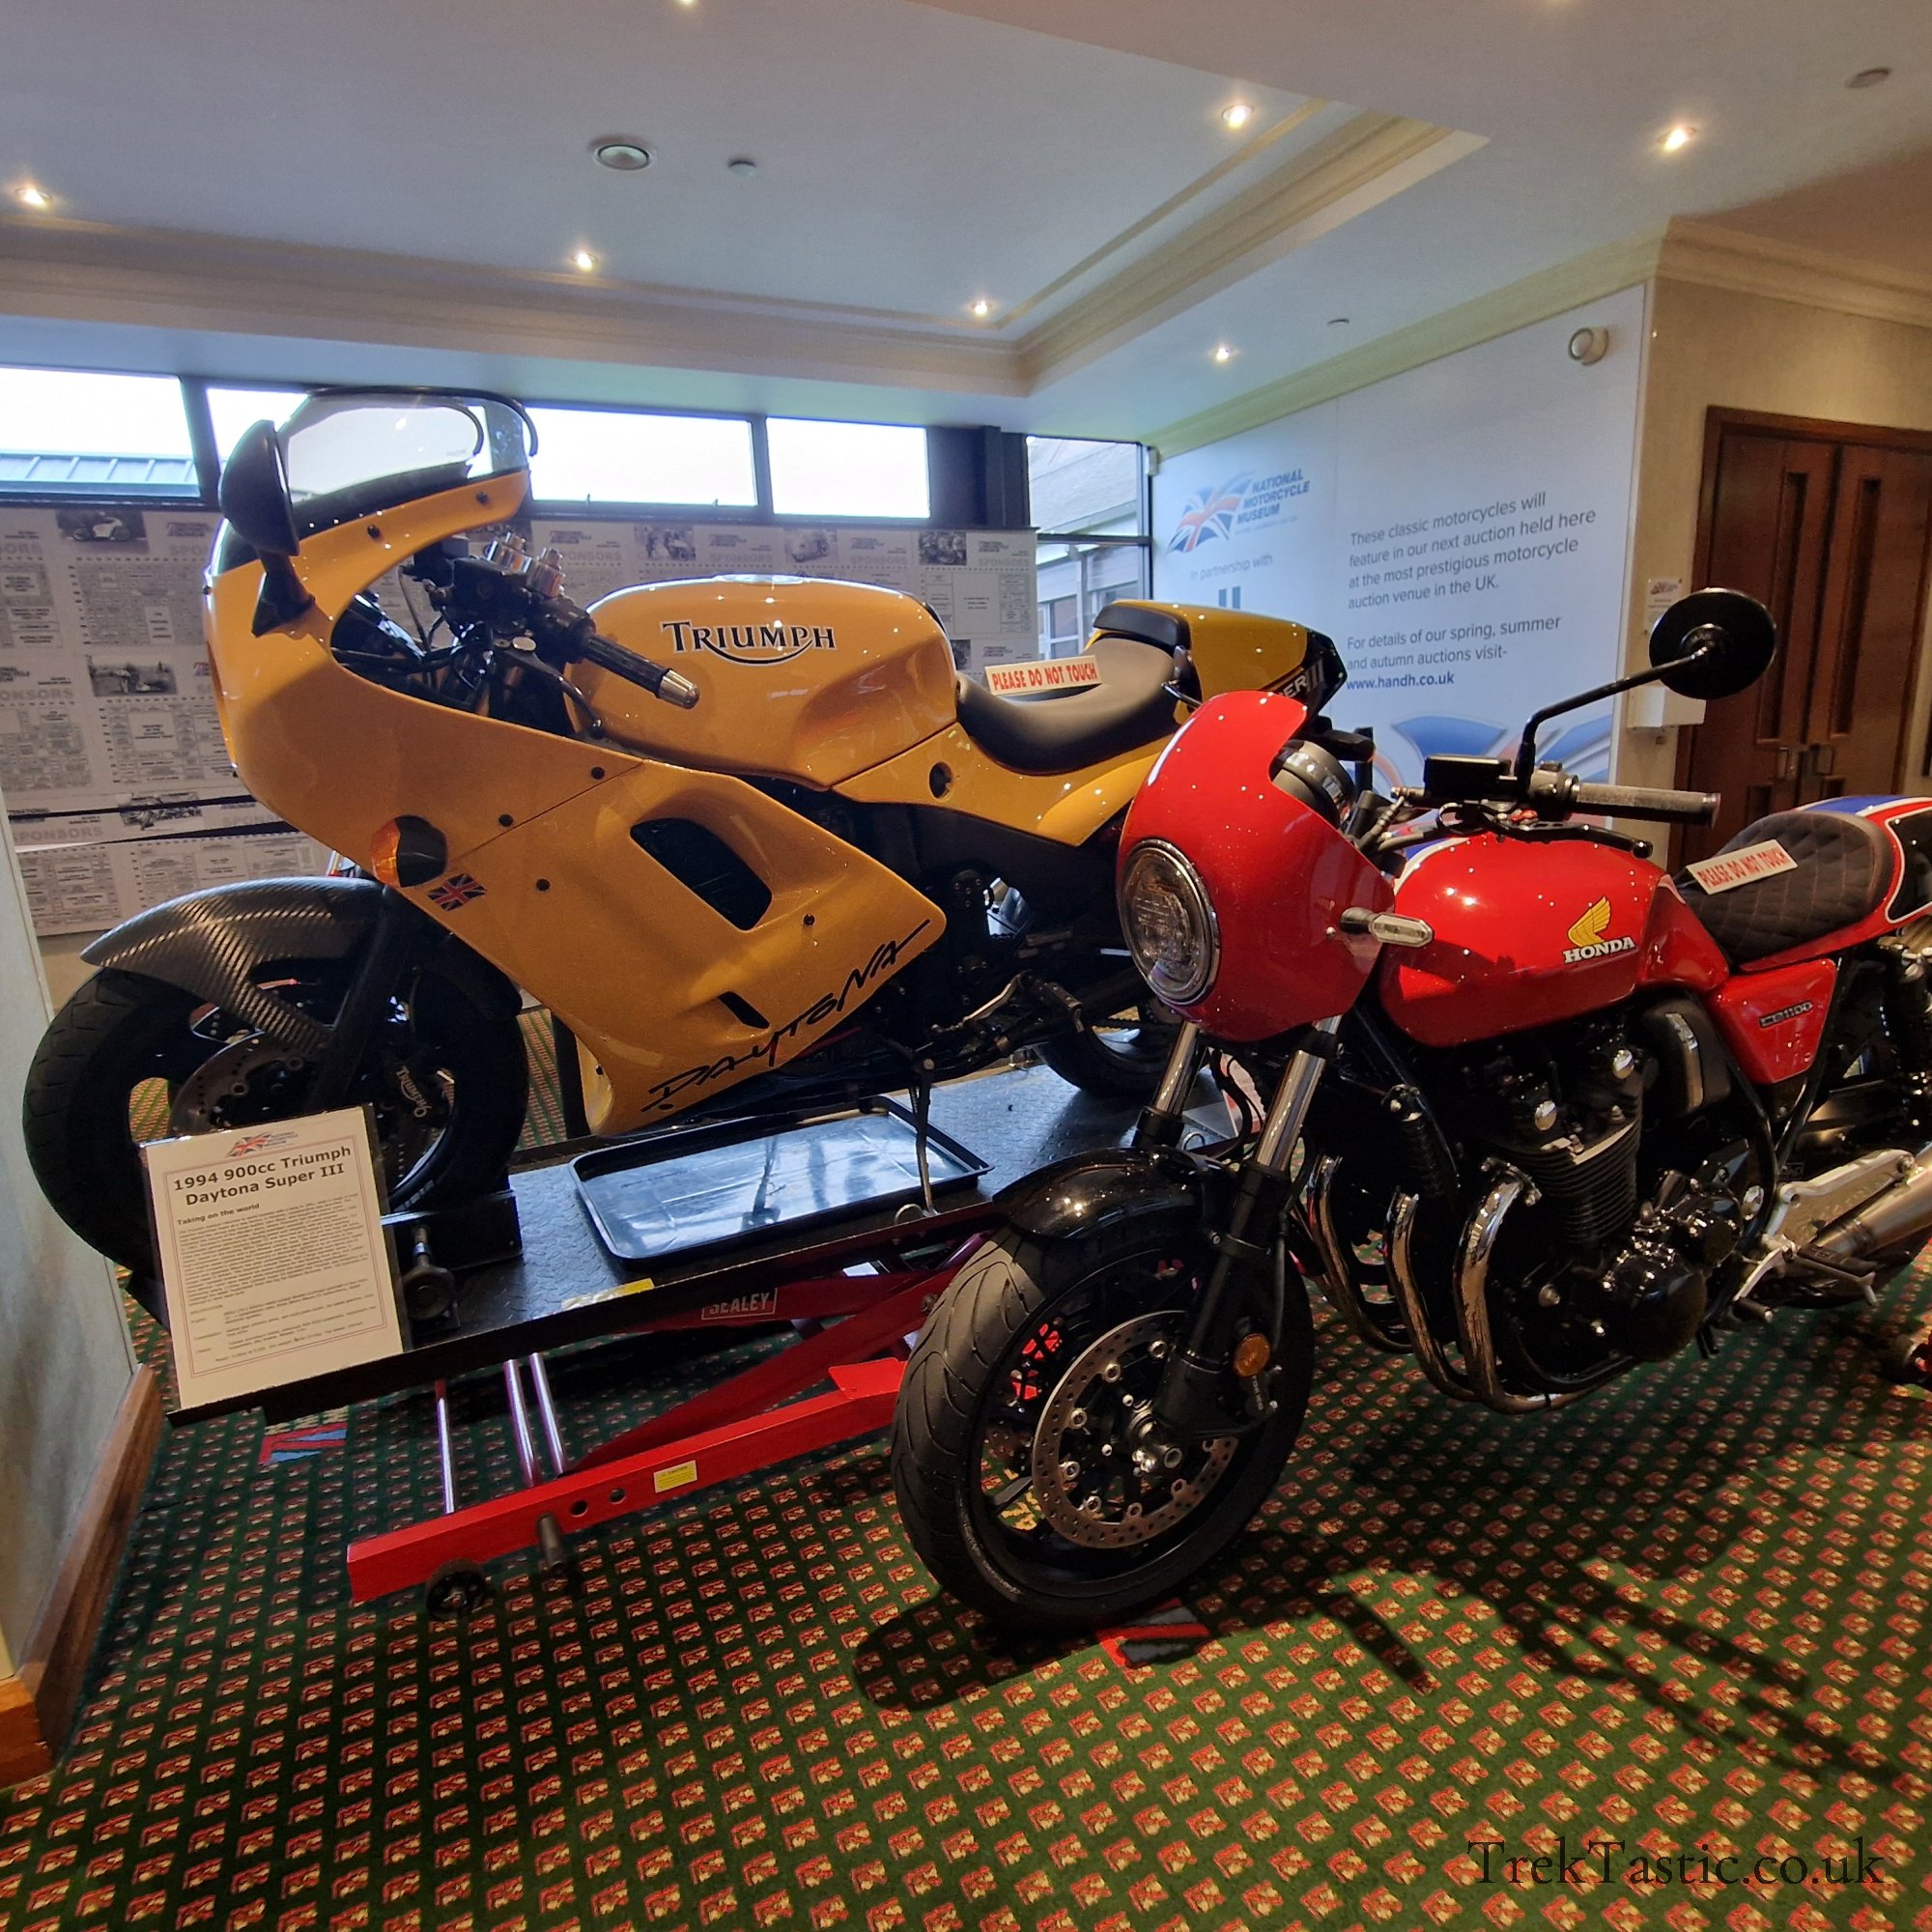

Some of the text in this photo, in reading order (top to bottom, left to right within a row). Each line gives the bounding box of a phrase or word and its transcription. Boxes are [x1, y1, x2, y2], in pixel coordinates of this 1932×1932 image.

[1243, 481, 1311, 508] MOTORCYCLE
[1252, 469, 1304, 494] NATIONAL
[1236, 504, 1280, 525] MUSEUM
[1350, 491, 1546, 547] These classic motorcycles will
[1350, 510, 1596, 568] feature in our next auction held here
[1190, 553, 1273, 580] In partnership with
[1349, 538, 1578, 588] at the most prestigious motorcycle
[1349, 574, 1499, 609] auction venue in the UK.
[660, 620, 838, 655] TRIUMPH
[1347, 616, 1562, 650] For details of our spring, summer
[1347, 644, 1507, 670] and autumn auctions visit-
[991, 663, 1097, 691] PLEASE DO NOT TOUCH
[1347, 671, 1455, 690] www.handh.co.uk
[1696, 865, 1734, 887] PLEASE
[1739, 854, 1765, 874] NOT
[1562, 936, 1636, 963] HONDA
[174, 1146, 352, 1191] 1994 900cc Triumph
[185, 1162, 345, 1207] Daytona Super III
[177, 1203, 260, 1226] Taking on the world
[709, 1292, 770, 1315] SEALEY
